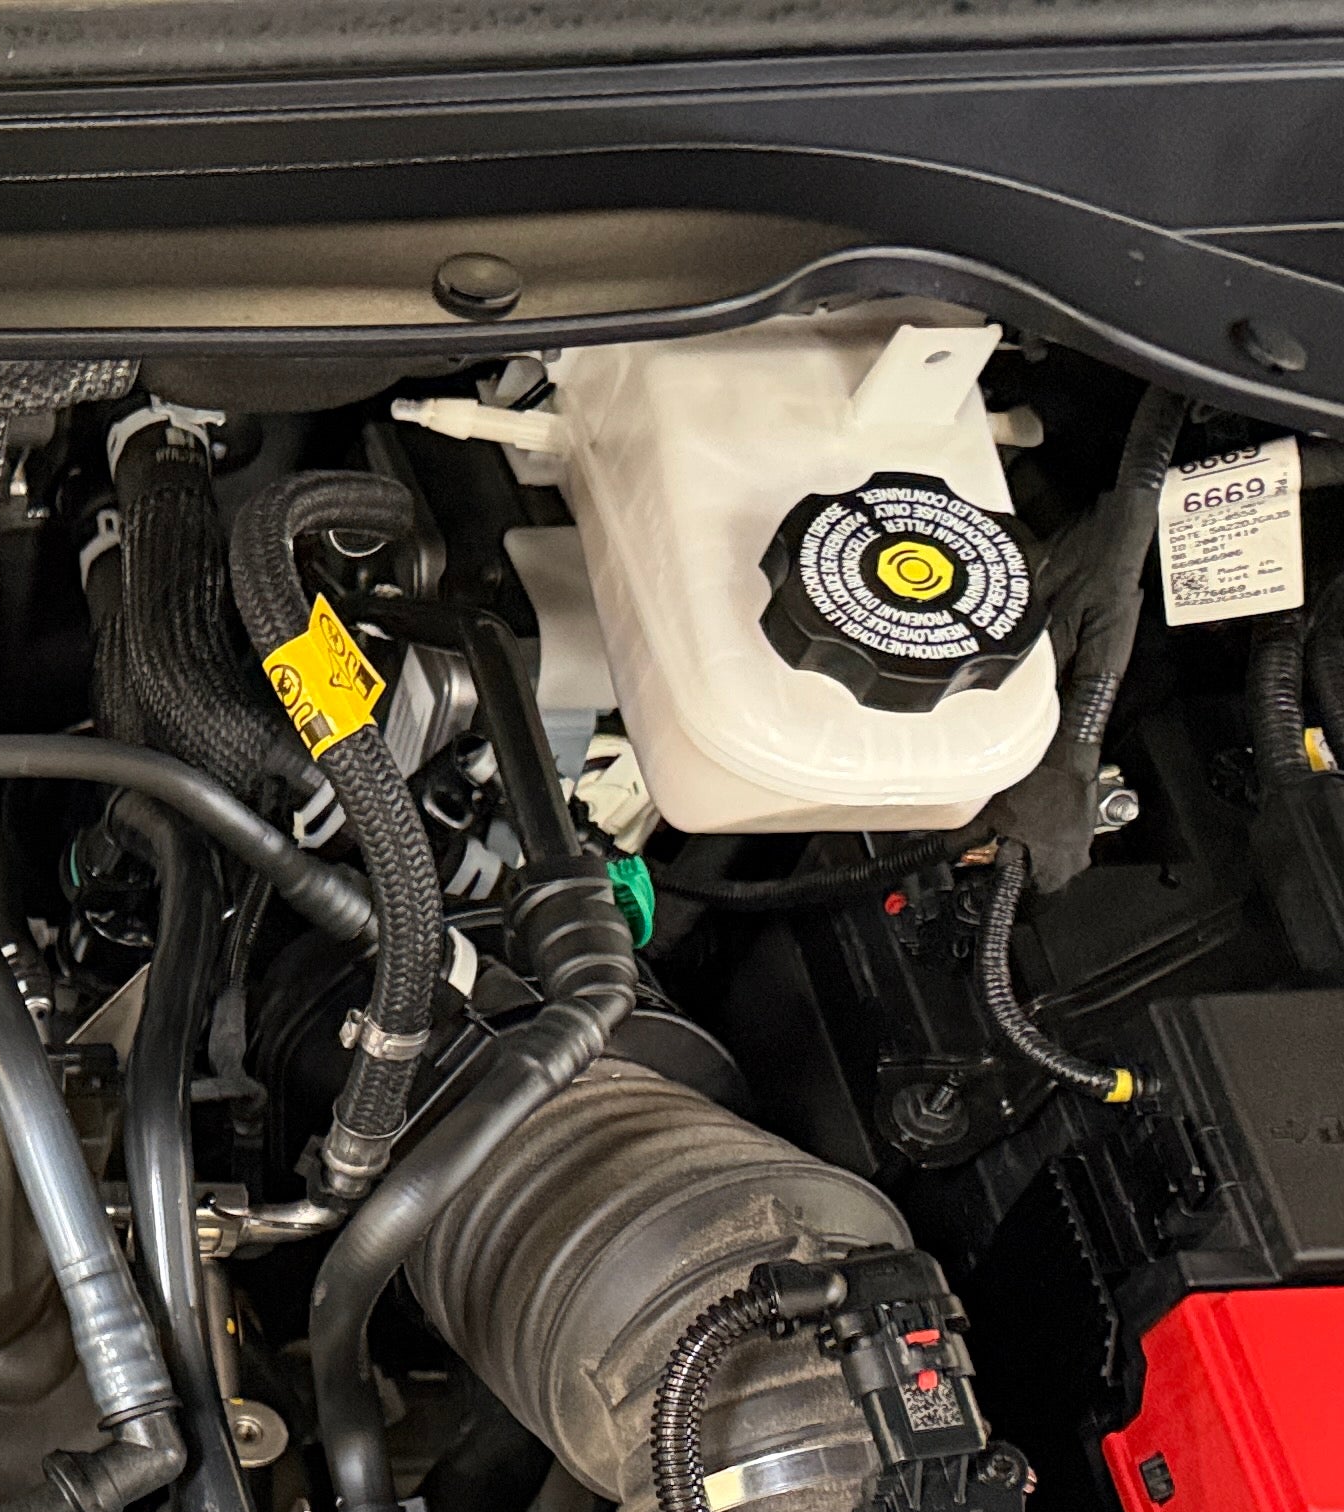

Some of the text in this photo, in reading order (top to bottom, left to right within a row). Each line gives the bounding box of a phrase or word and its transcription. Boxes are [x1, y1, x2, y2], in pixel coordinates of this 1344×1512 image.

[874, 503, 912, 519] ONLY
[1184, 478, 1265, 512] 6669
[947, 500, 1002, 536] SEALED
[799, 533, 822, 568] AVANT
[820, 558, 839, 573] DE
[997, 542, 1028, 576] FROM
[841, 558, 865, 589] BIDON
[881, 518, 986, 619] WARNING: CLEAN FILLER
[800, 567, 837, 614] BOUCHON
[821, 573, 857, 610] LIQUIDE
[983, 562, 1011, 610] BEFORE
[1006, 577, 1030, 612] FLUID
[825, 609, 848, 626] LE
[846, 604, 870, 622] DU
[862, 614, 892, 635] QUE
[873, 603, 954, 627] PROVENANT
[970, 602, 998, 627] CAP
